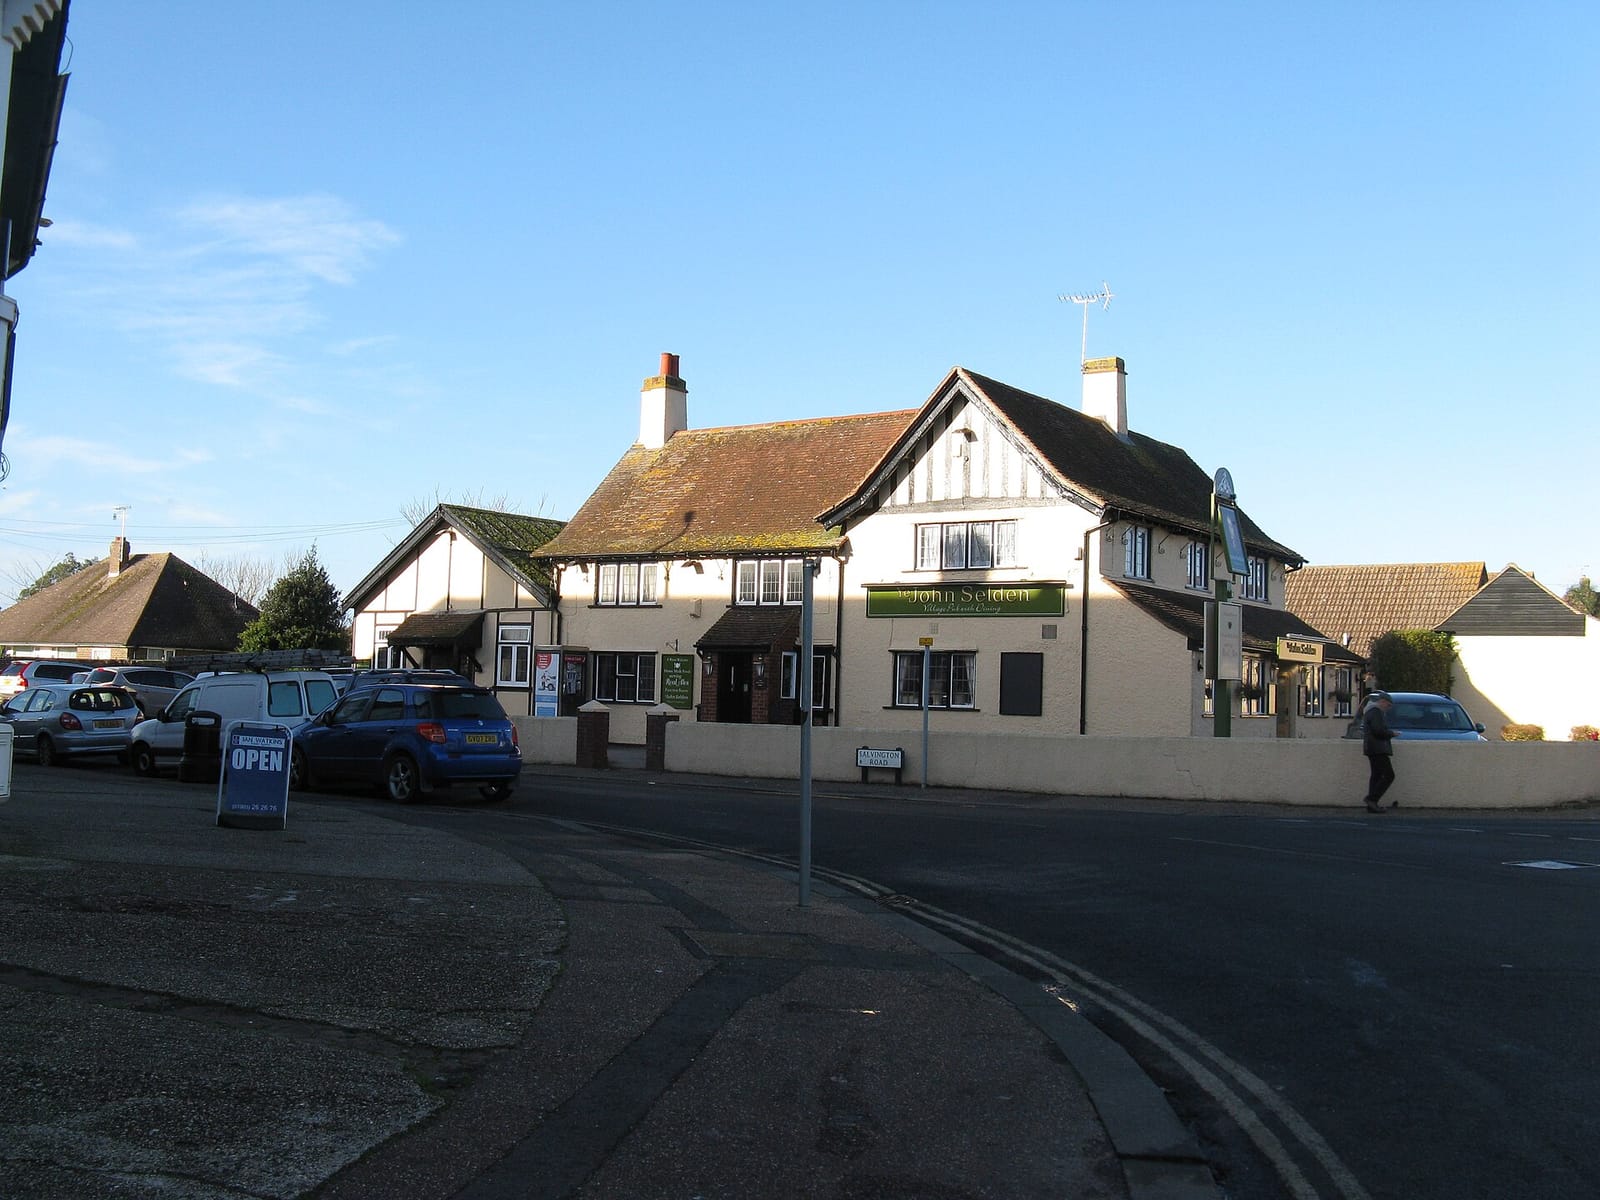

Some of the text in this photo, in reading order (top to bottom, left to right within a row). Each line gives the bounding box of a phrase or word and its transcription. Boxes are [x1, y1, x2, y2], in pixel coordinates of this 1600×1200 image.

[897, 586, 1030, 604] Ye John Selden
[232, 748, 283, 772] OPEN
[859, 751, 900, 759] SALVINGTON
